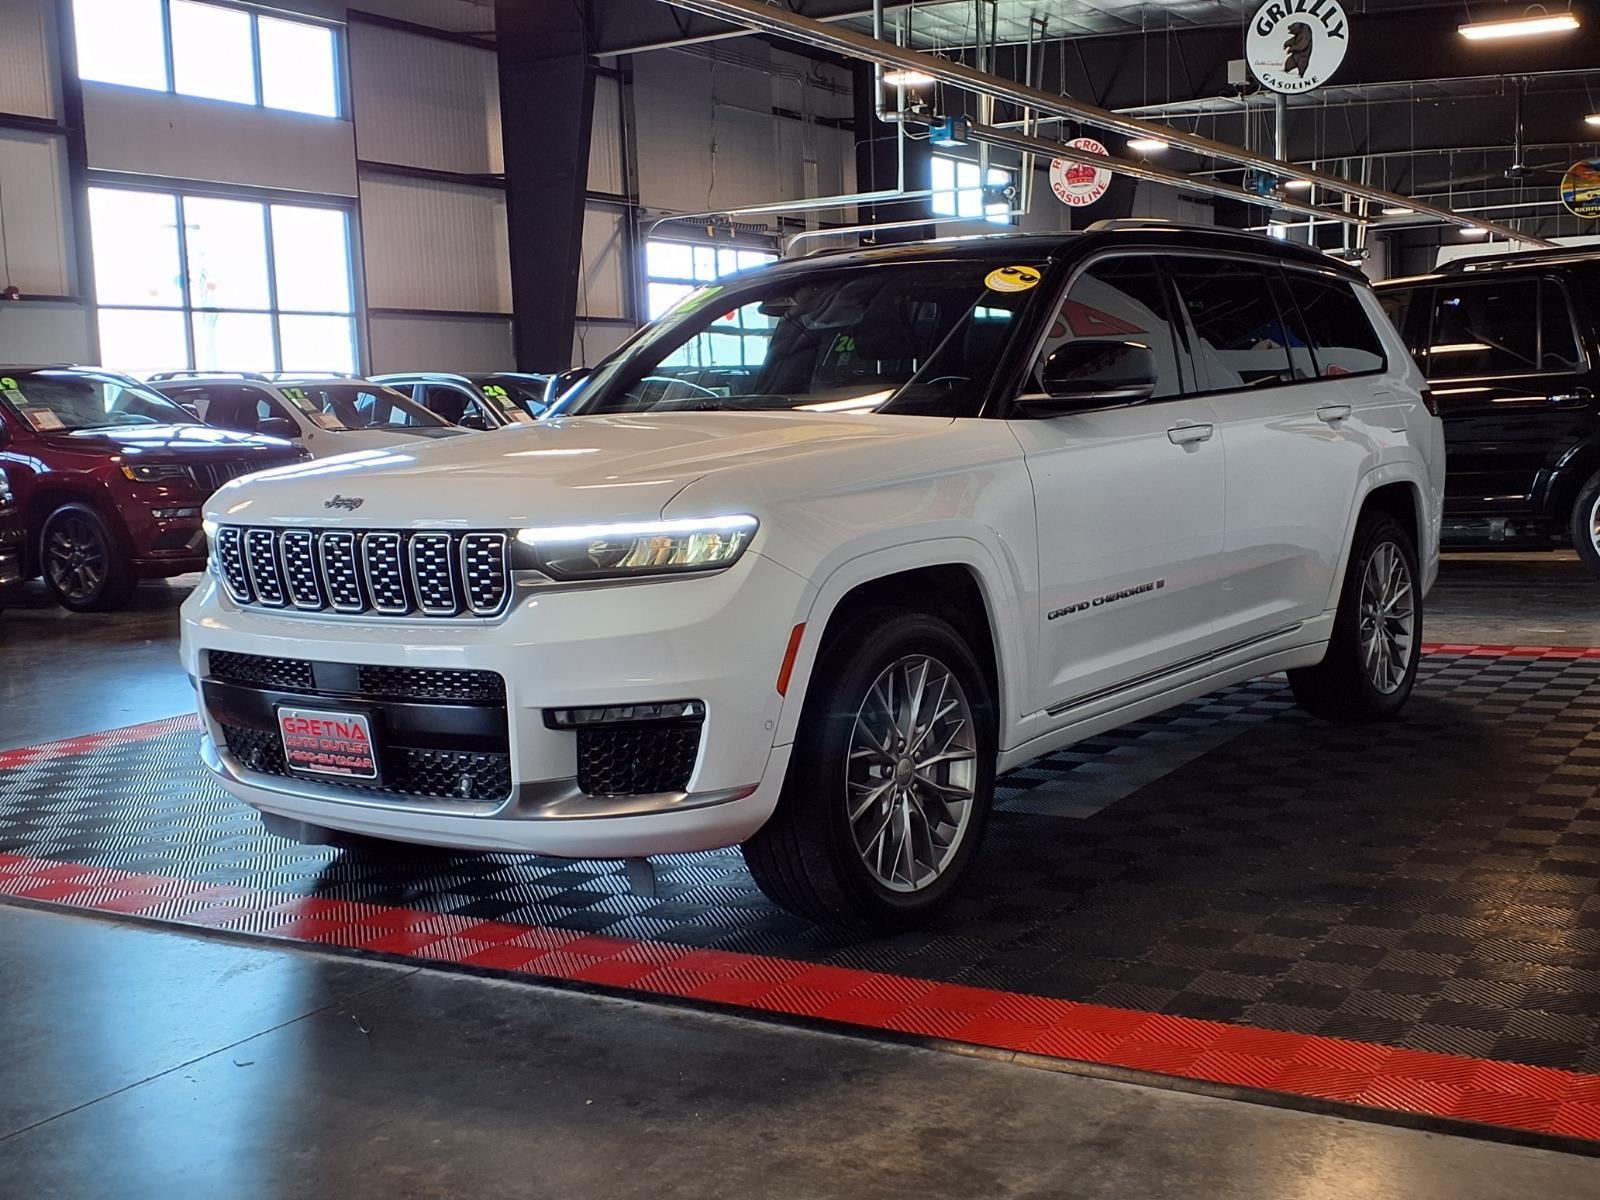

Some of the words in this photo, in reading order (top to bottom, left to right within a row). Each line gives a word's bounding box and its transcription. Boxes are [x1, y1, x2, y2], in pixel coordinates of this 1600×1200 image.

[1256, 0, 1345, 40] GRIZZLY
[1262, 73, 1320, 90] GASOLINE
[1053, 182, 1107, 205] GASOLINE
[324, 494, 364, 511] Jeep
[1047, 600, 1090, 620] GRAND
[1091, 582, 1155, 607] CHEROKEE
[283, 716, 367, 740] GRETNA
[286, 736, 319, 749] AUTO
[320, 739, 369, 754] OUTLET
